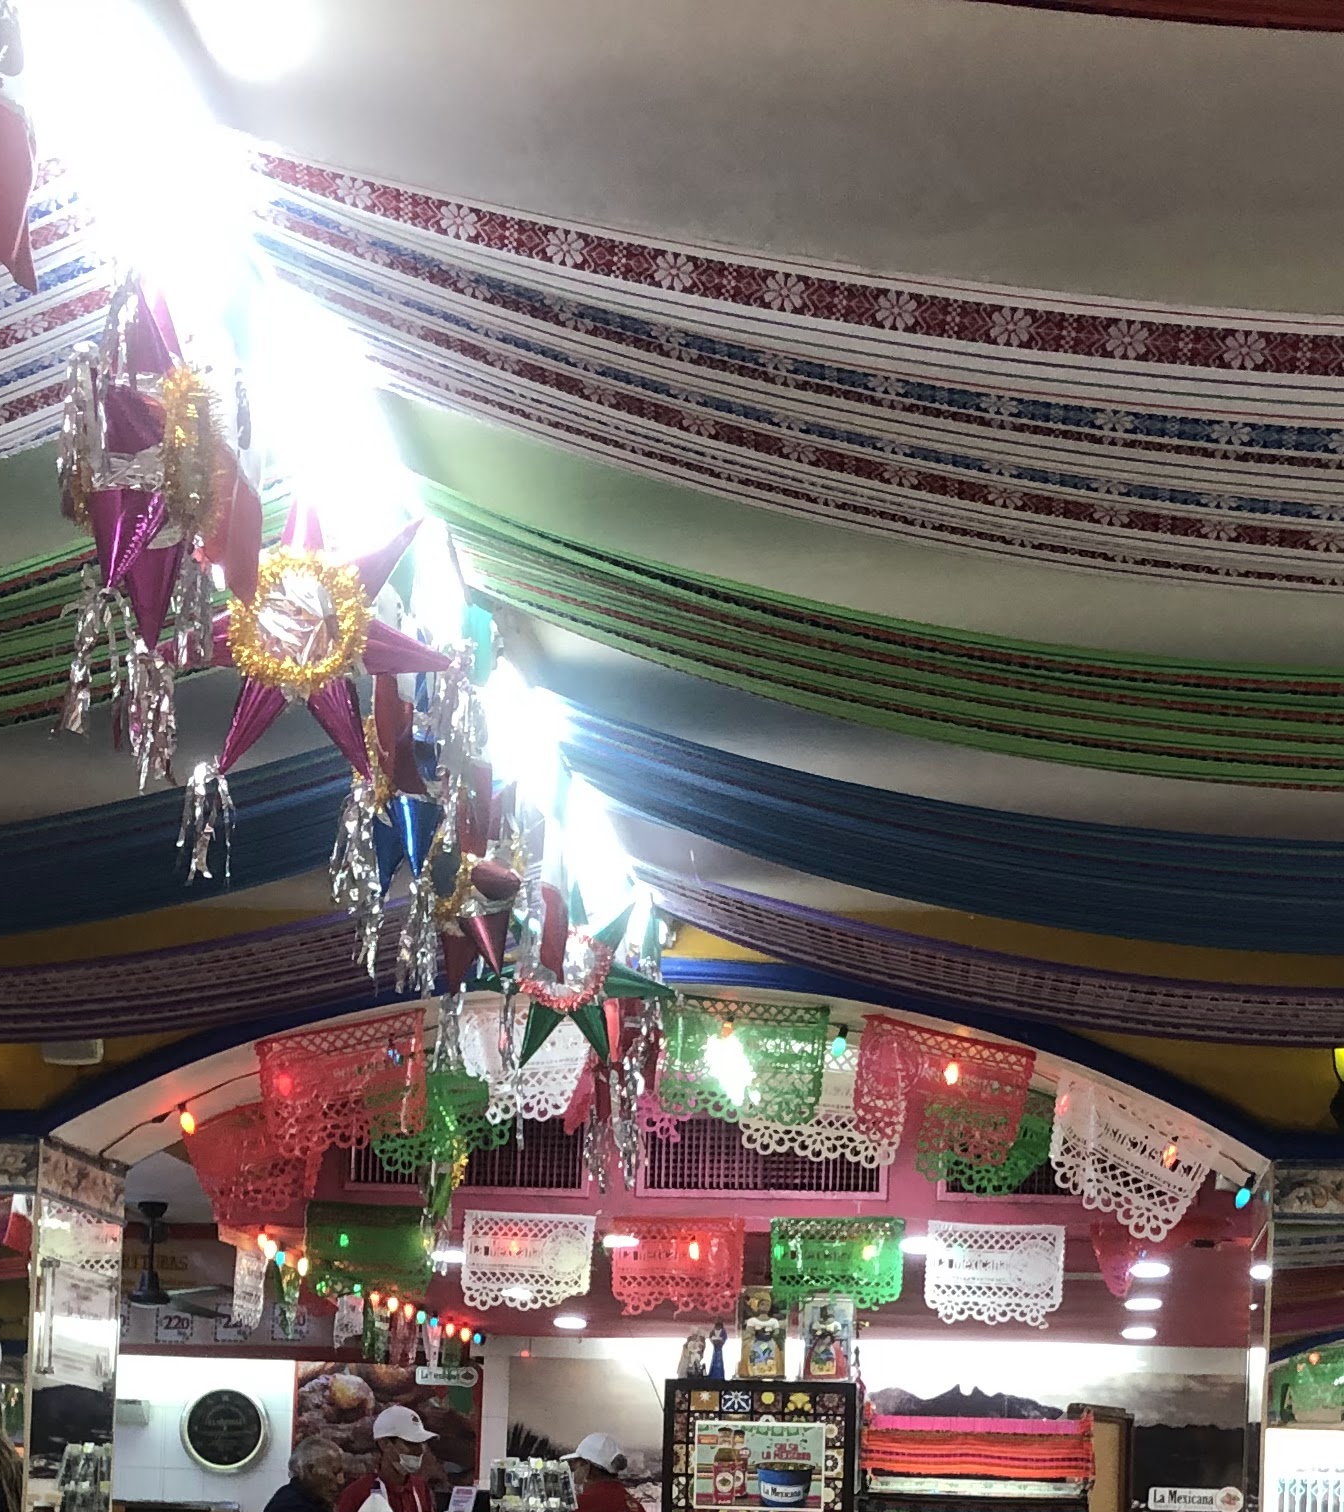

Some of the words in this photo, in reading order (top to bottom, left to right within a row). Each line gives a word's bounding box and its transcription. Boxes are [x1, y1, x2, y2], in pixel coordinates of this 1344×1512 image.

[762, 1483, 769, 1495] La
[770, 1486, 802, 1498] Mexicana
[1153, 1489, 1165, 1504] La
[1168, 1490, 1214, 1506] Mexicana
